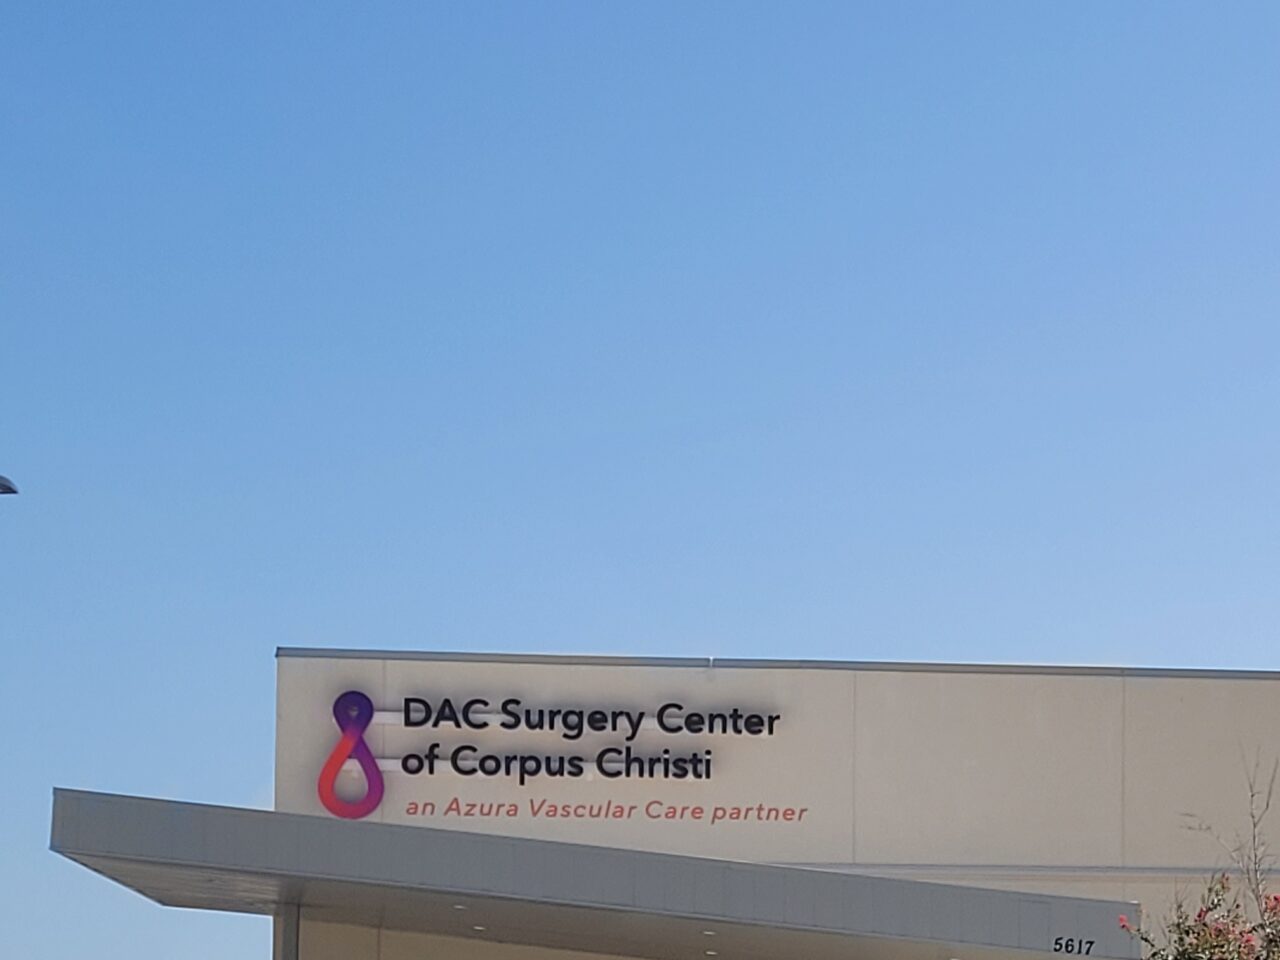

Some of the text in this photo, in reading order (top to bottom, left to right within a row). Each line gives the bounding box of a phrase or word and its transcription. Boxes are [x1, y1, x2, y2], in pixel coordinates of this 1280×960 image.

[402, 697, 781, 741] DAC Surgery Center
[401, 743, 713, 785] of Corpus Christi
[405, 797, 809, 825] an Azura Vascular Care partner
[1053, 936, 1095, 956] 5617
